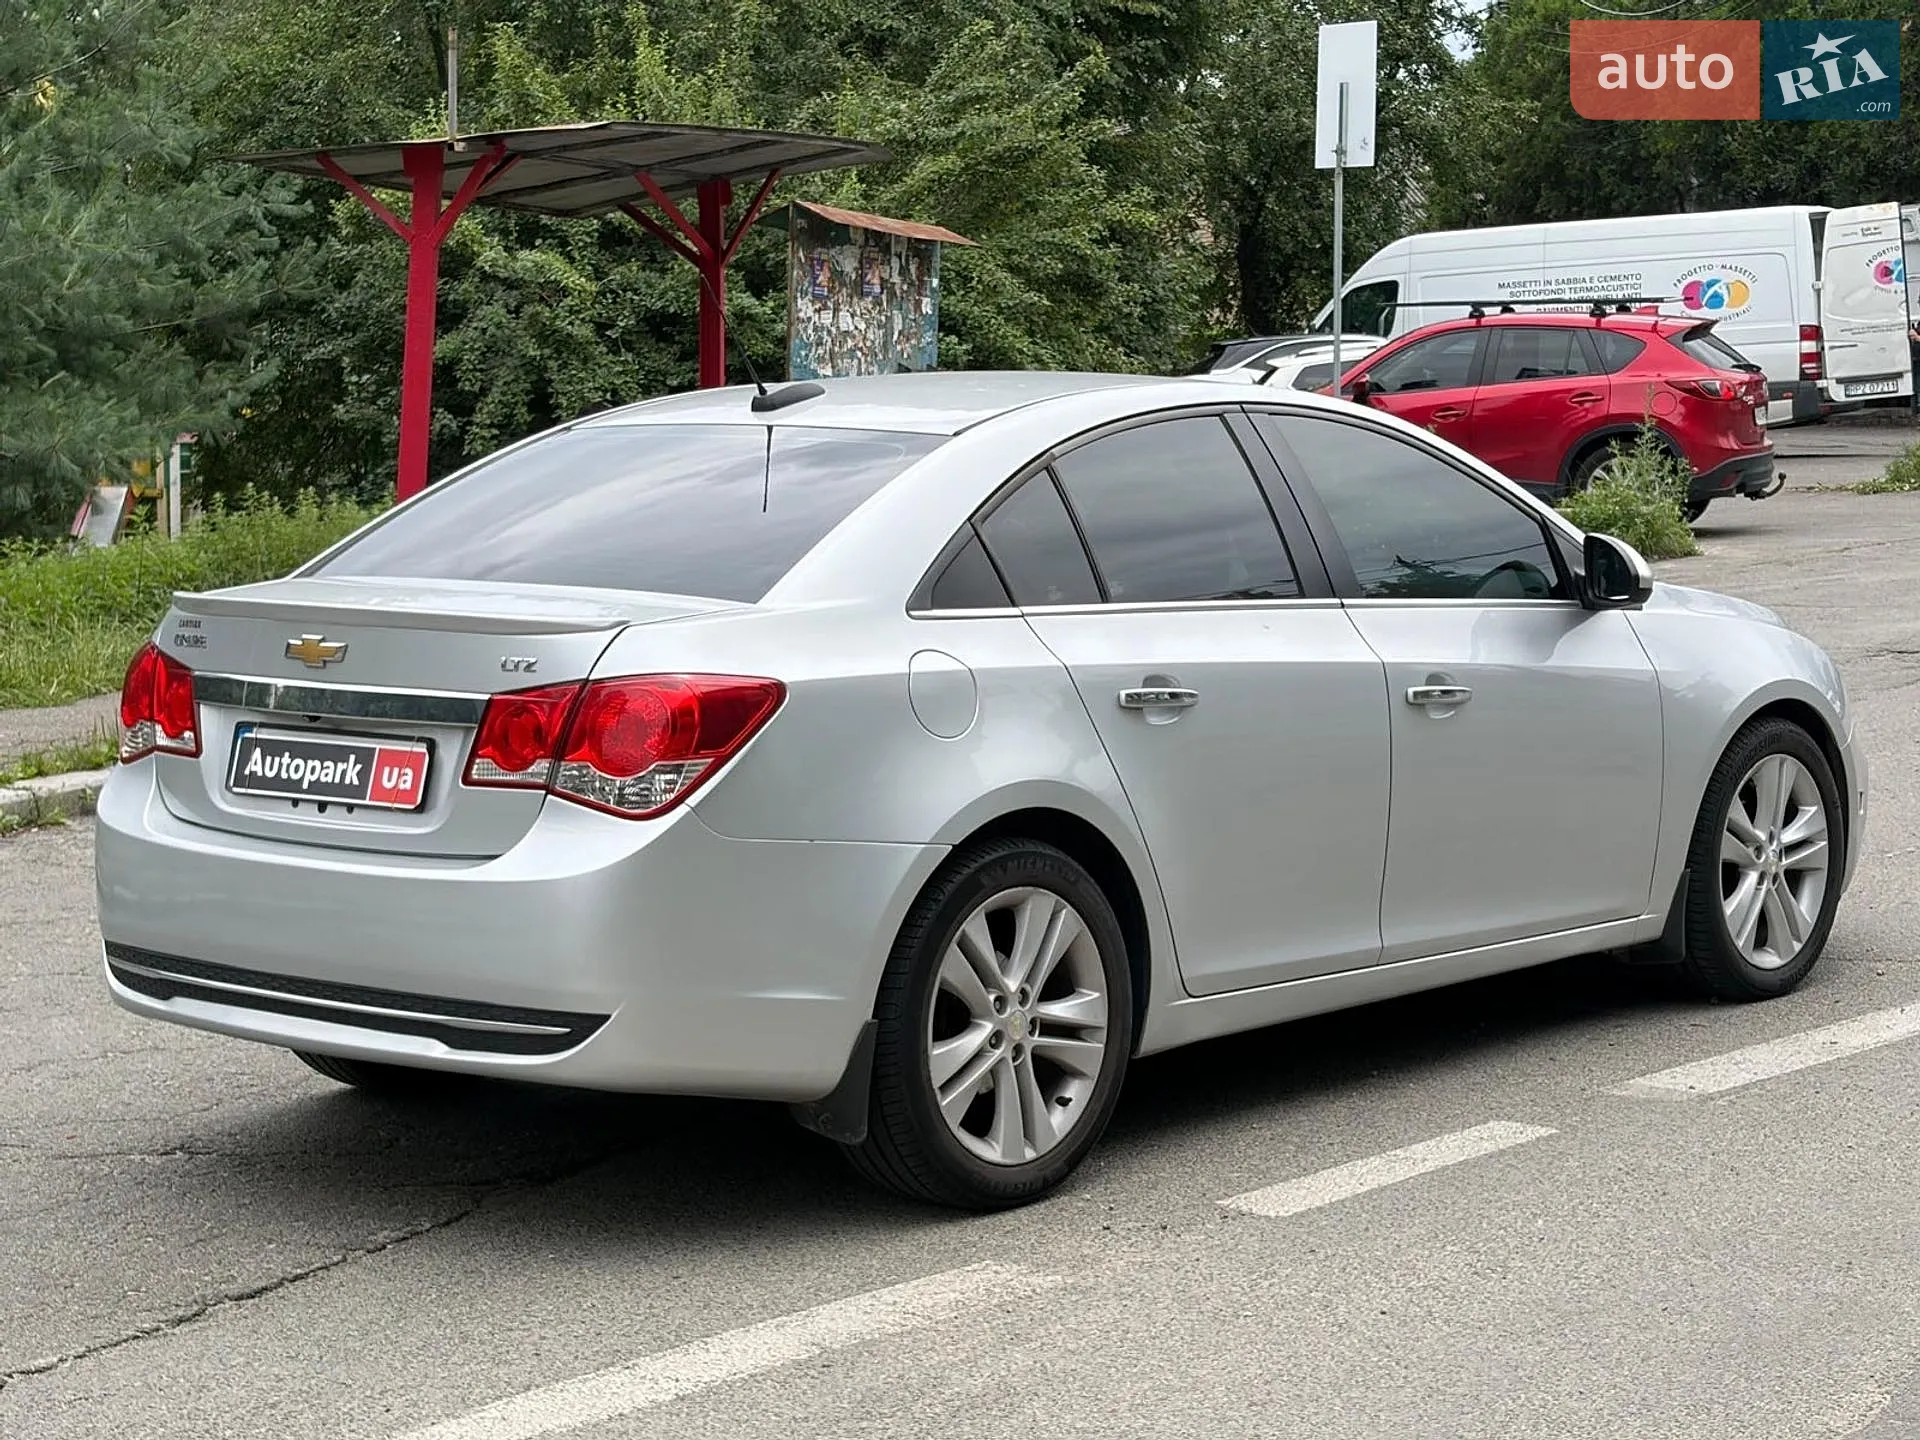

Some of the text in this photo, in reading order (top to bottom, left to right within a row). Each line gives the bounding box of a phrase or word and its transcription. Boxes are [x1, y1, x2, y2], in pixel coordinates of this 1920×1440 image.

[1498, 273, 1642, 289] MASSETTI IN SABBIA E CEMENTO
[1673, 263, 1758, 288] PROGETTO MASSETTI
[1509, 283, 1642, 299] SOTTOFONDI TERMOACUSTICI
[500, 656, 538, 672] LTZ
[244, 747, 414, 791] Autopark ua
